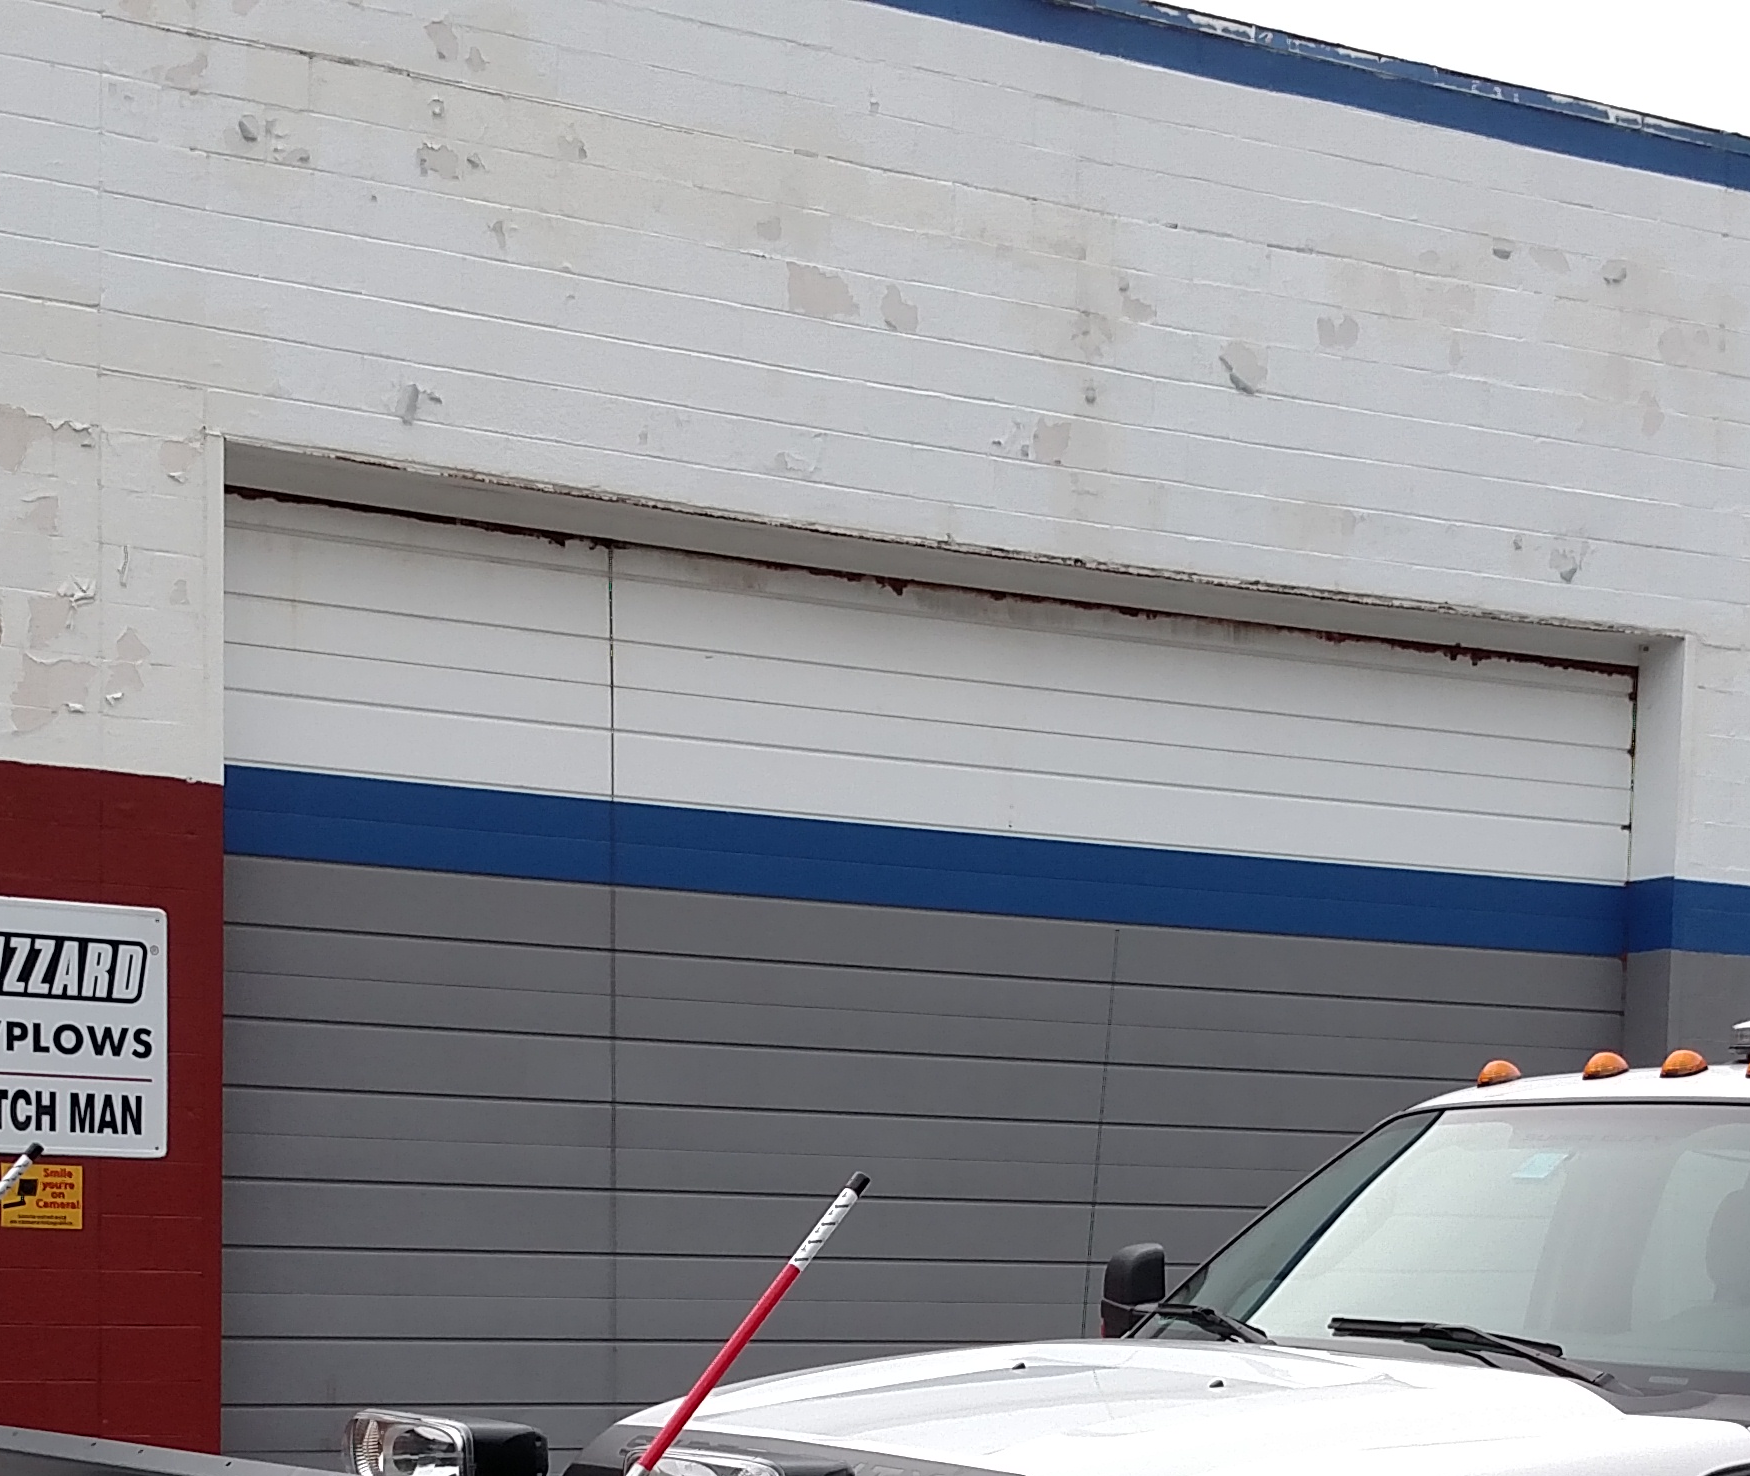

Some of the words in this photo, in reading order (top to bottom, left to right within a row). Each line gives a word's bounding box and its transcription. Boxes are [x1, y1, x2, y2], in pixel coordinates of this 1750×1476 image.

[69, 1092, 143, 1135] MAN
[43, 1168, 74, 1178] Smile
[51, 1191, 65, 1199] on
[35, 1199, 80, 1210] Camera!
